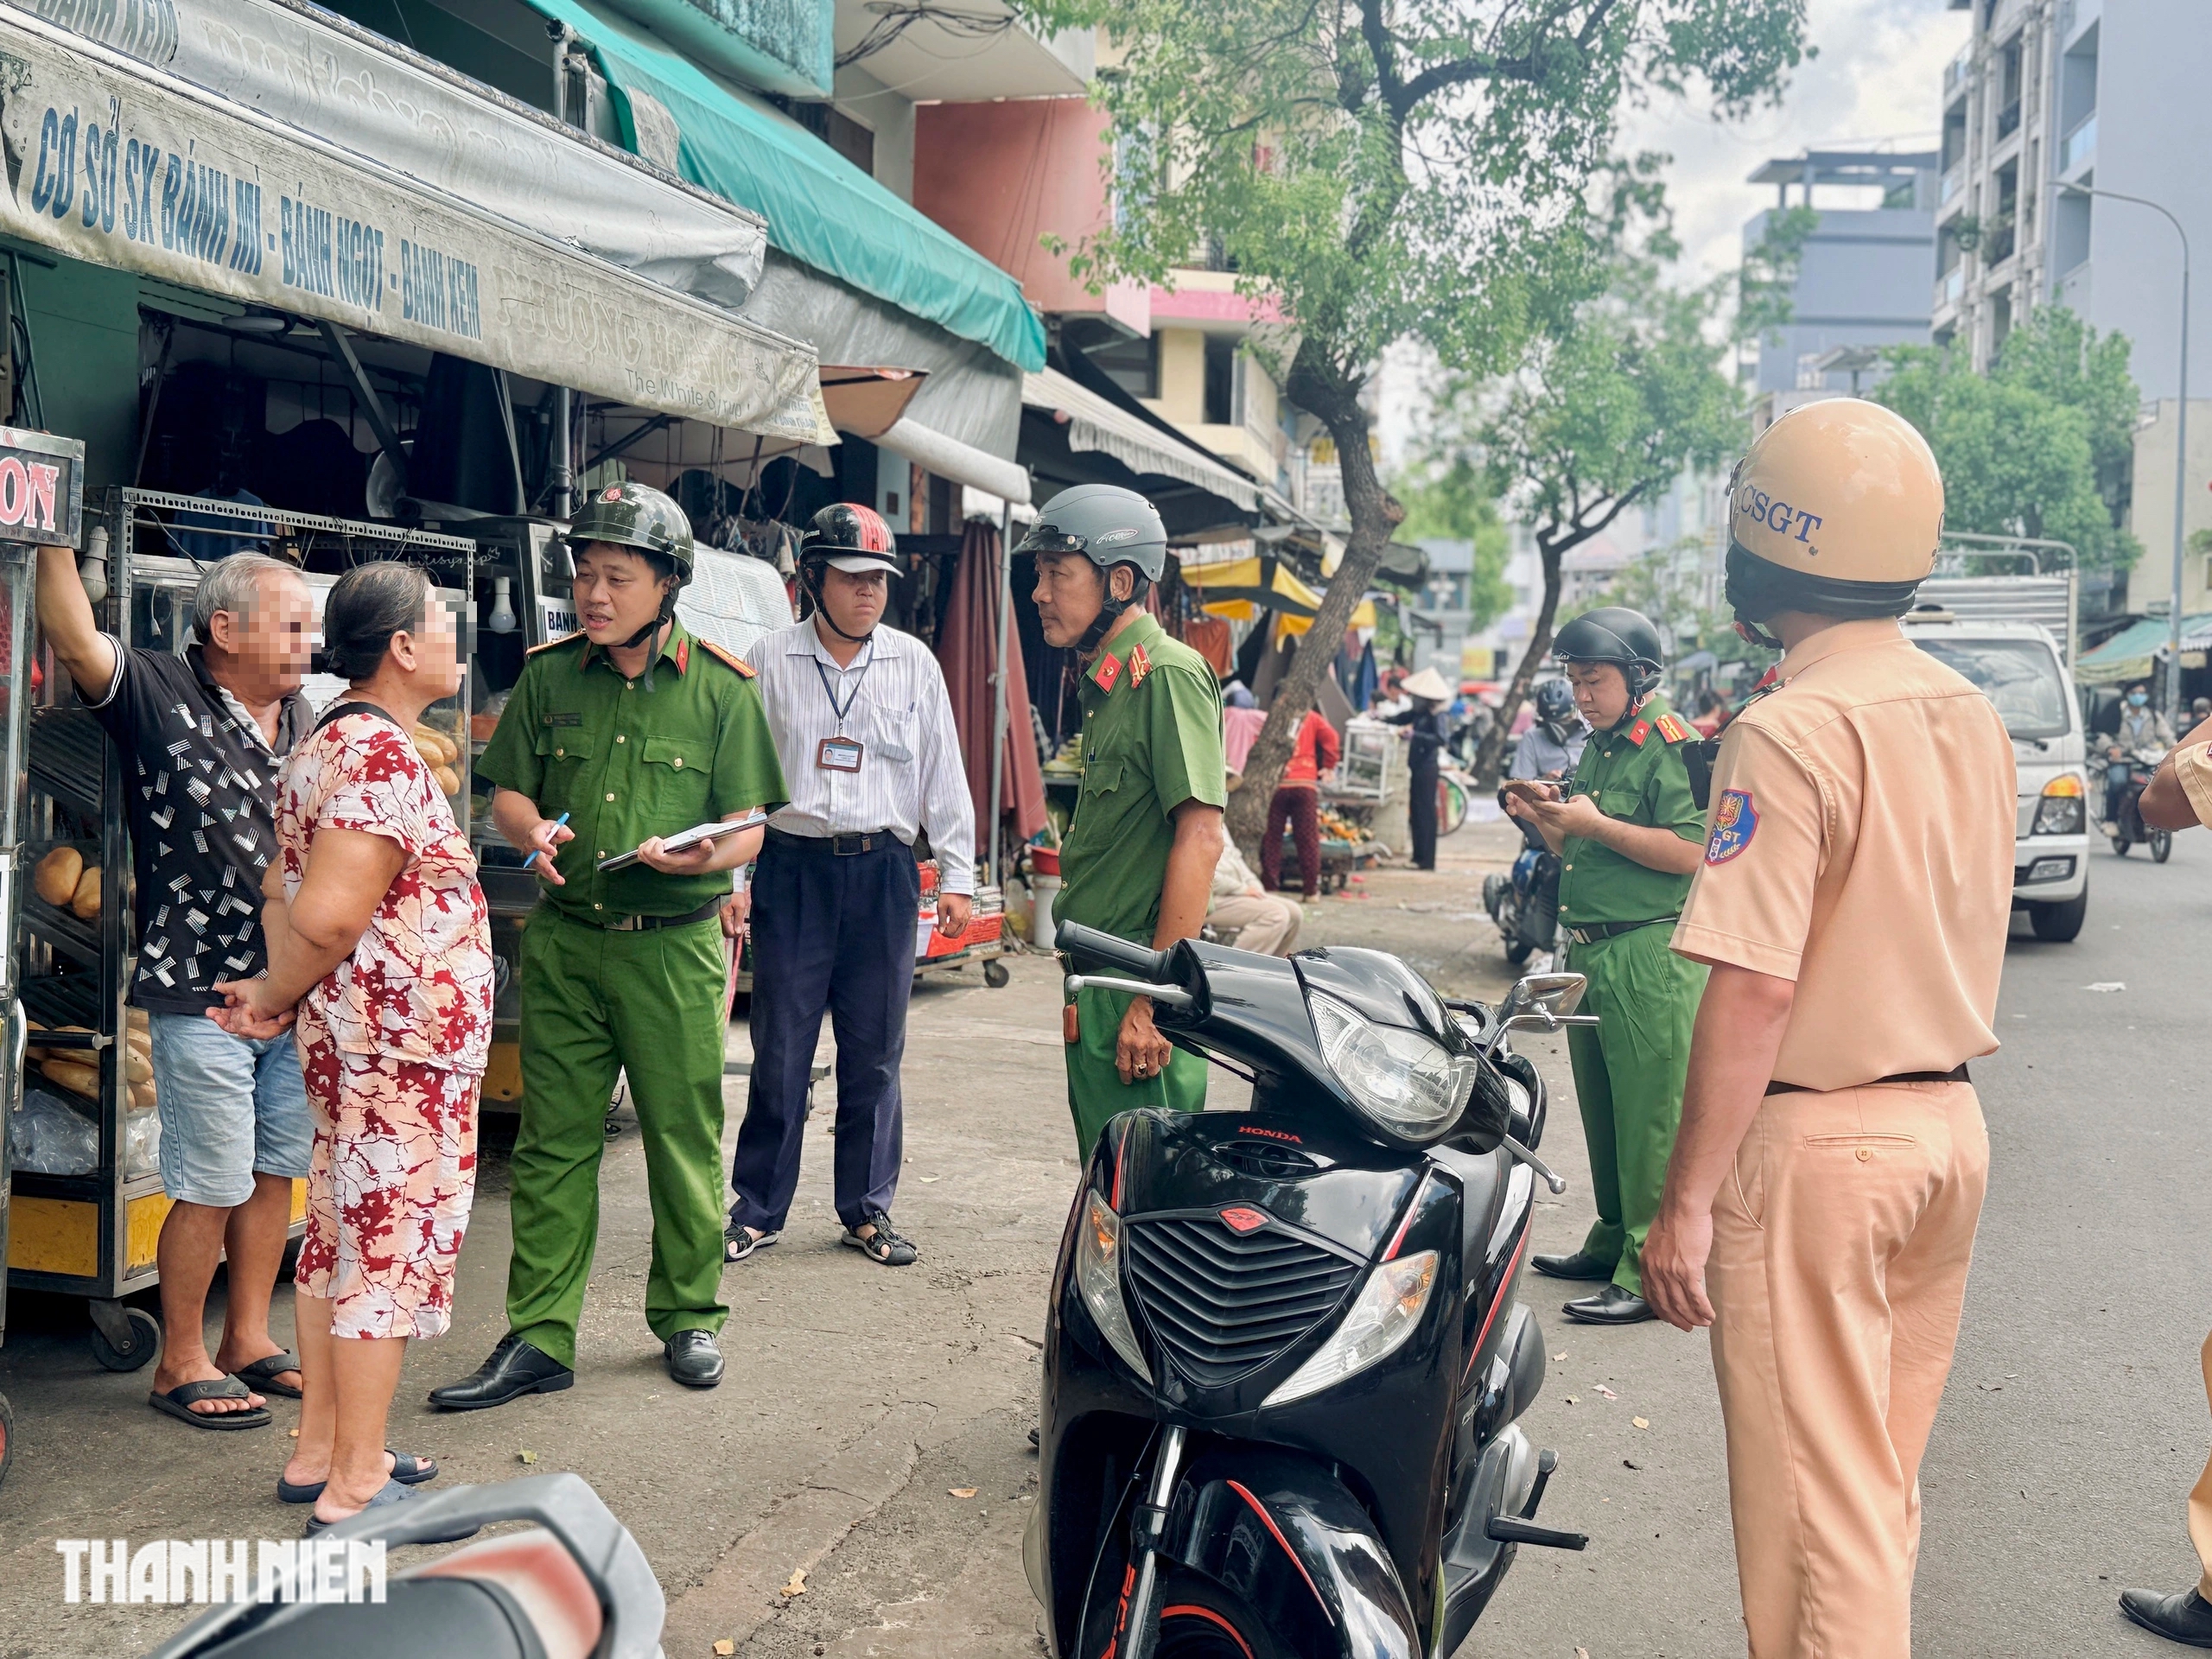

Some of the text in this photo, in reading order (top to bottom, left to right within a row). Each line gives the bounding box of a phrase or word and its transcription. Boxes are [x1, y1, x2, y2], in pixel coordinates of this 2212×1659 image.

[31, 105, 79, 219] CƠ
[82, 95, 121, 234] SỞ
[124, 138, 161, 245] SX
[161, 139, 229, 266] BÁNH
[229, 164, 263, 276] MÌ
[280, 181, 335, 298] BÁNH
[337, 215, 384, 328] NGỌT
[401, 224, 447, 330] BÁNH
[447, 255, 481, 340] KEM
[625, 368, 656, 395] The
[659, 378, 703, 406] White
[1740, 484, 1823, 543] CSGT
[1238, 1126, 1303, 1145] HONDA
